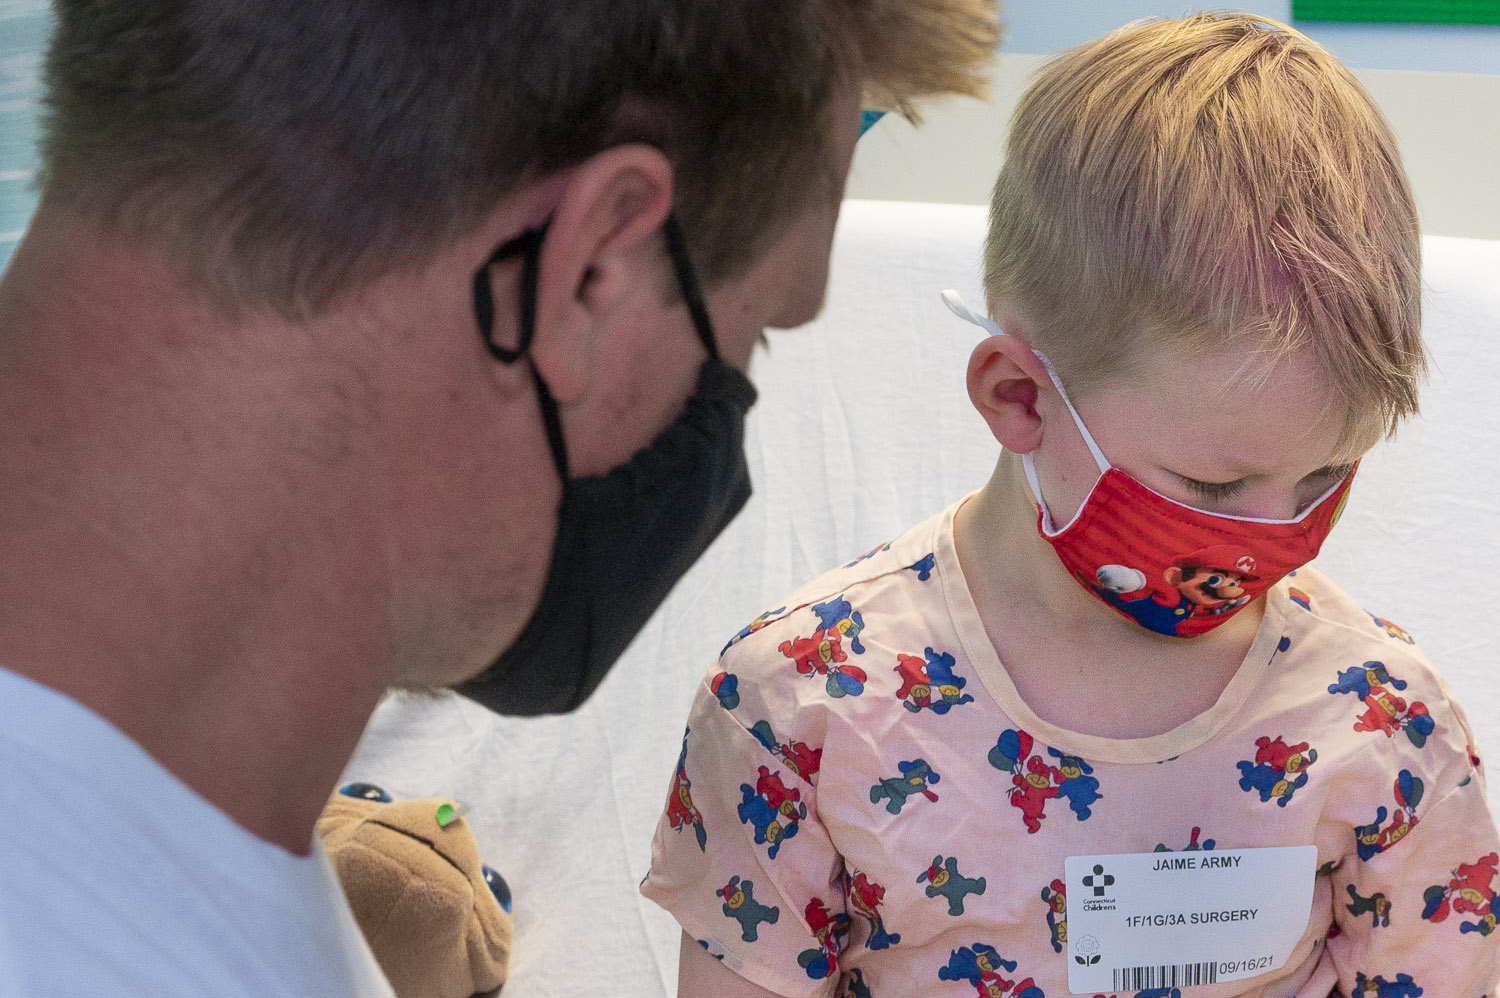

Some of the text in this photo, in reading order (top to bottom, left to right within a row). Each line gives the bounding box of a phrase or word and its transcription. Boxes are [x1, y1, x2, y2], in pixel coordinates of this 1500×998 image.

[1152, 856, 1242, 871] JAIME ARMY
[1125, 909, 1259, 928] 1F/1G/3A SURGERY
[1219, 955, 1275, 975] 09/16/21
